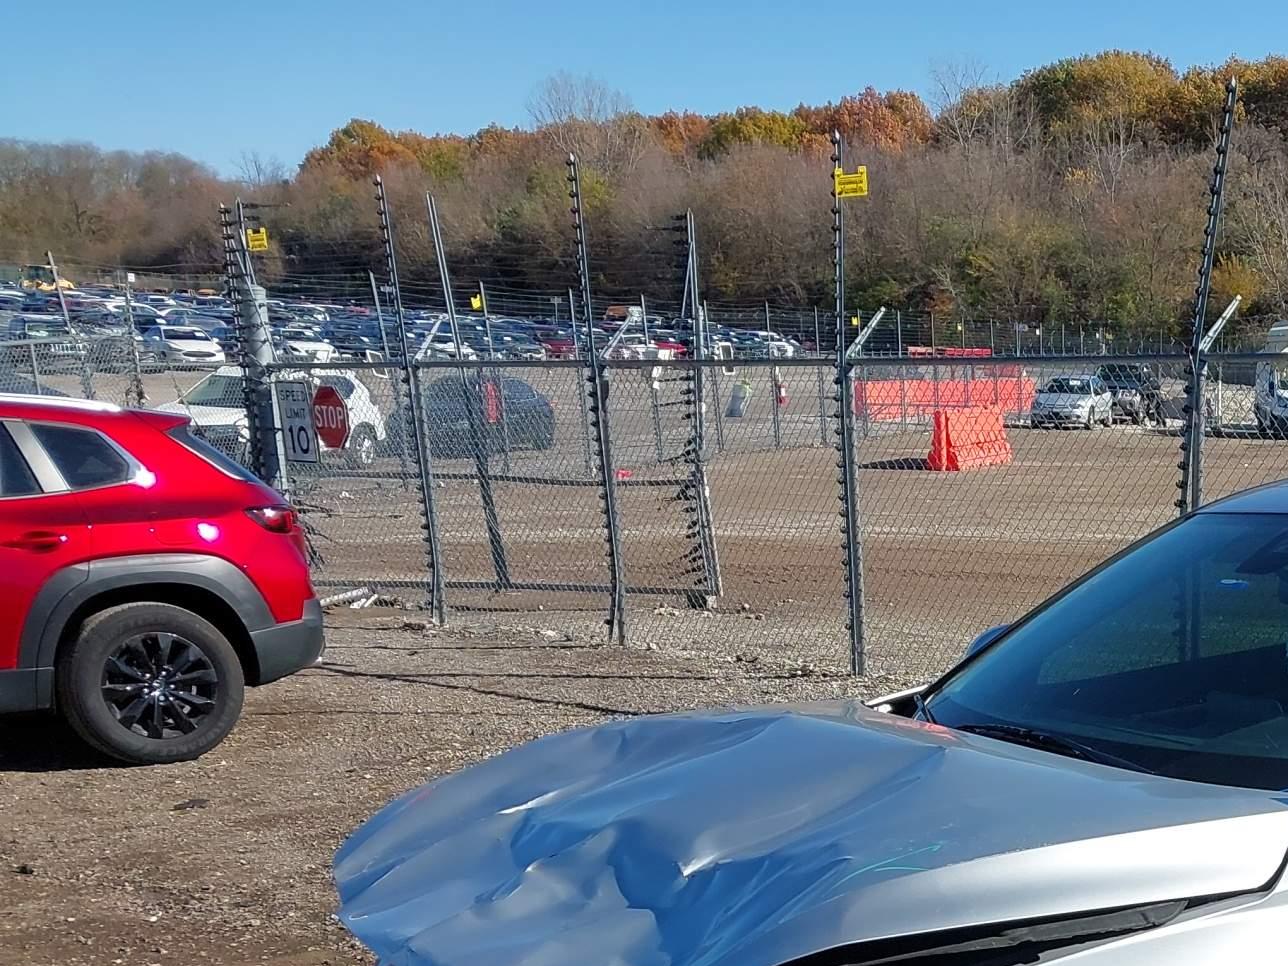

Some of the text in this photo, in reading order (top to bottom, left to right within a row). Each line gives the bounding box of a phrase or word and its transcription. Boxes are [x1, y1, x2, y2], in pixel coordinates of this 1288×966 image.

[280, 390, 305, 401] SPEED
[285, 408, 306, 419] LIMIT
[314, 405, 344, 428] STOP
[288, 425, 310, 454] 10
